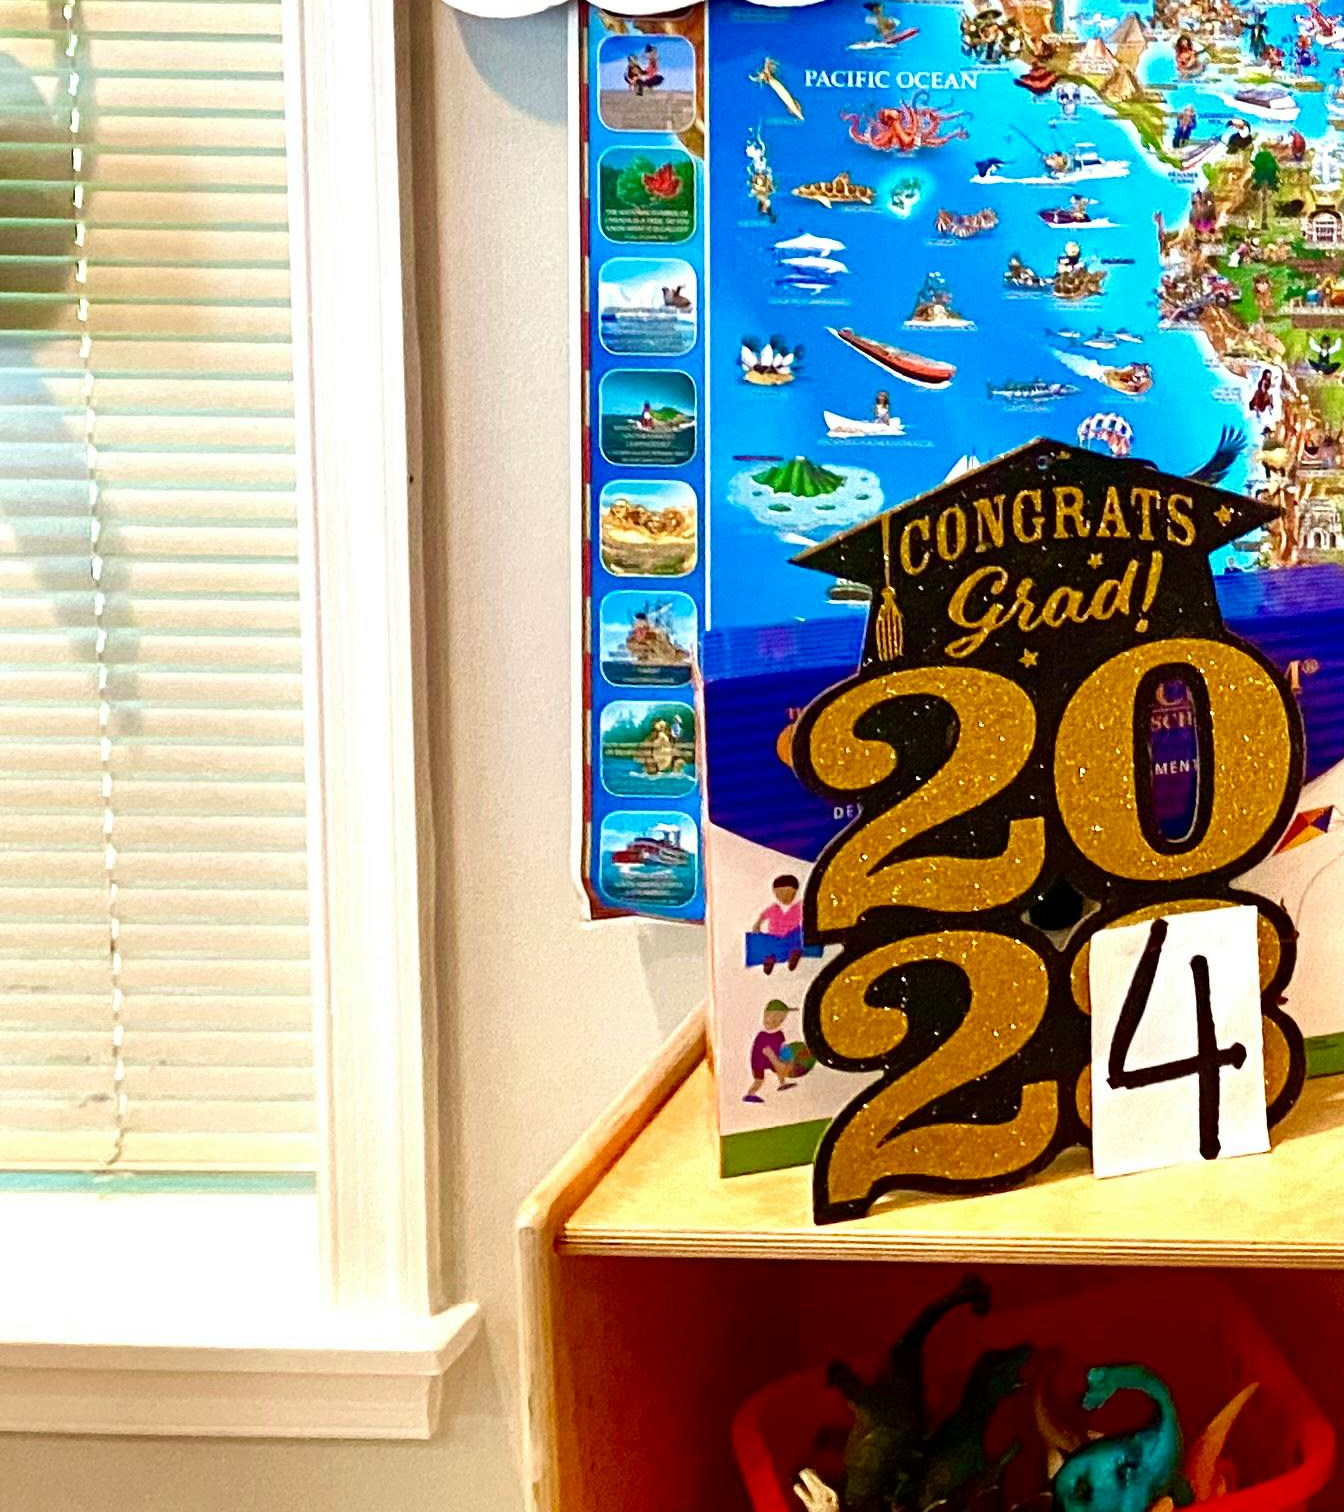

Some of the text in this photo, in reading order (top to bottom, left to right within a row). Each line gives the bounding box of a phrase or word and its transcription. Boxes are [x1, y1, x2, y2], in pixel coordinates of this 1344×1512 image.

[804, 69, 979, 90] PACIFIC OCEAN
[900, 487, 1196, 574] CONGRATS
[945, 551, 1162, 658] Grad!
[808, 638, 1290, 931] 20
